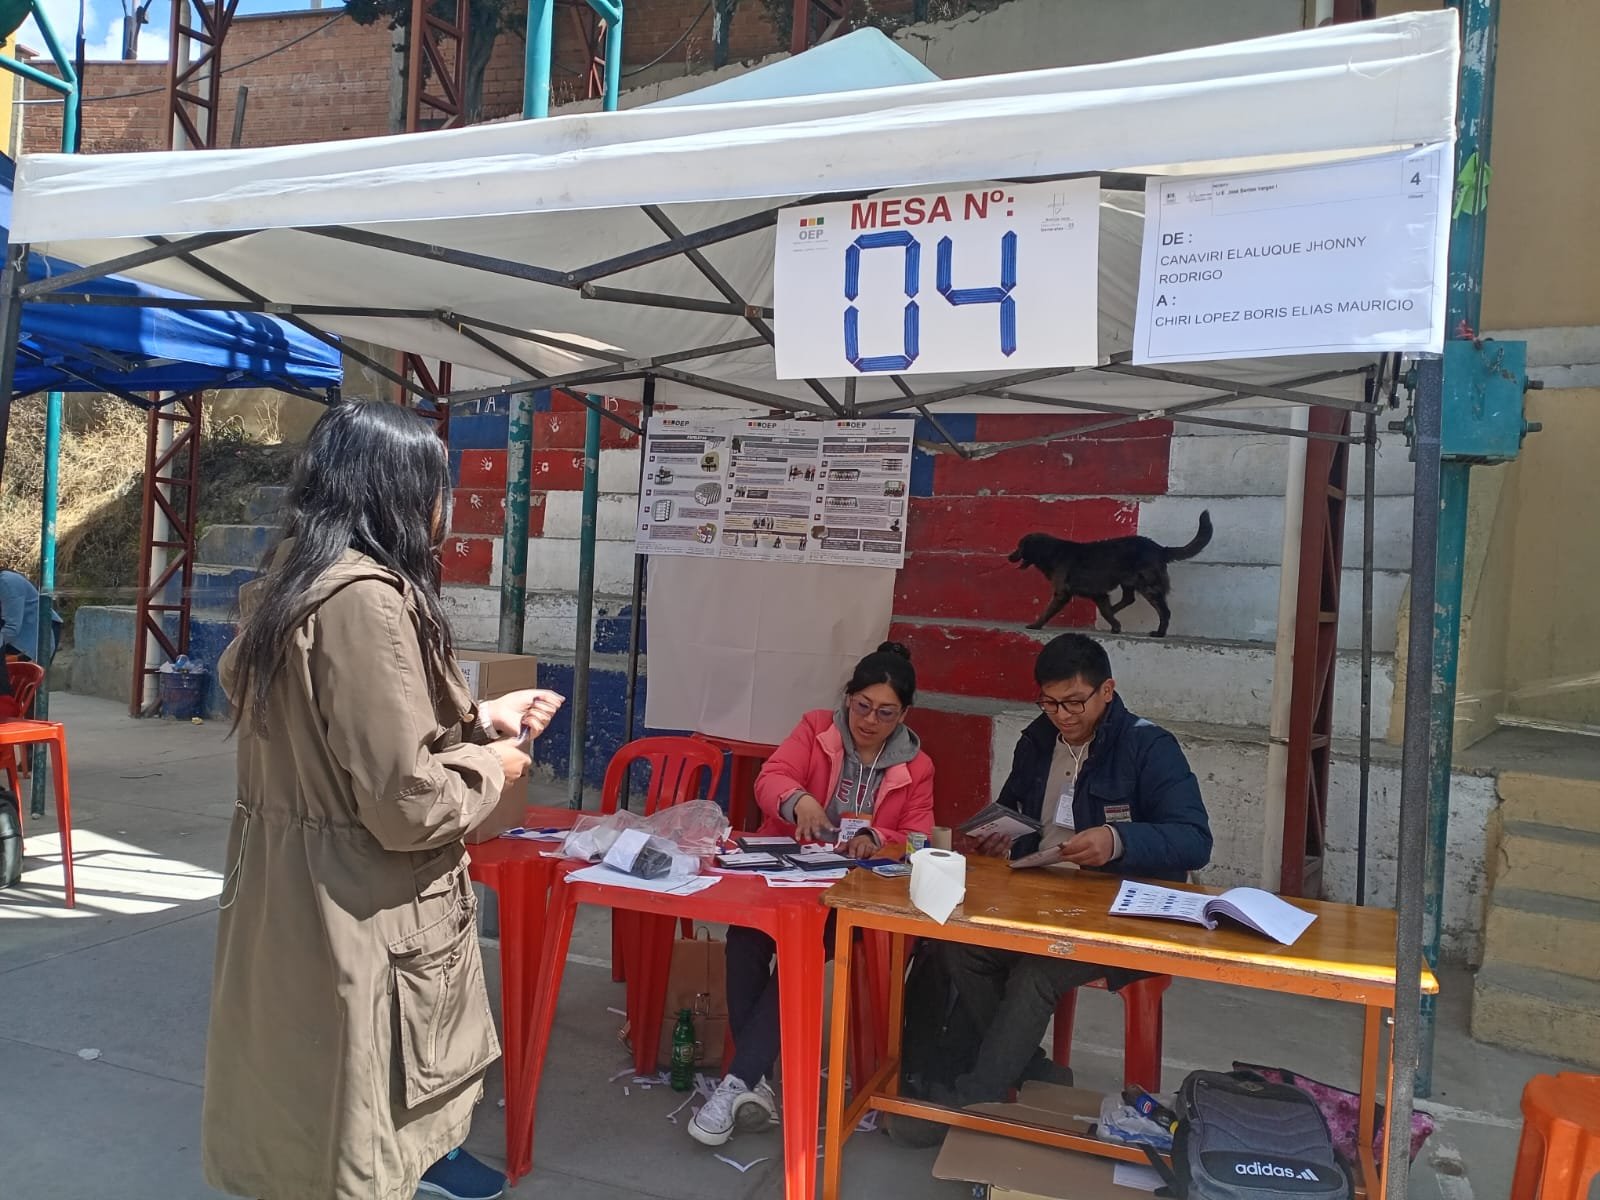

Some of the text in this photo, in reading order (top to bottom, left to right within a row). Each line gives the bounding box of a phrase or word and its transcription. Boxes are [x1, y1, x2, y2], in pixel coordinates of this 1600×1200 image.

[1410, 172, 1421, 186] 4
[851, 196, 953, 230] MESA
[798, 229, 824, 241] OEP
[1162, 232, 1184, 246] DE
[1160, 236, 1367, 266] CANAVIRI ELALUQUE JHONNY
[1159, 269, 1223, 284] RODRIGO
[844, 230, 1017, 372] 04
[1156, 295, 1168, 307] A
[1155, 299, 1414, 328] CHIRI LOPEZ BORIS ELIAS MAURICIO
[1235, 1161, 1295, 1178] adidas
